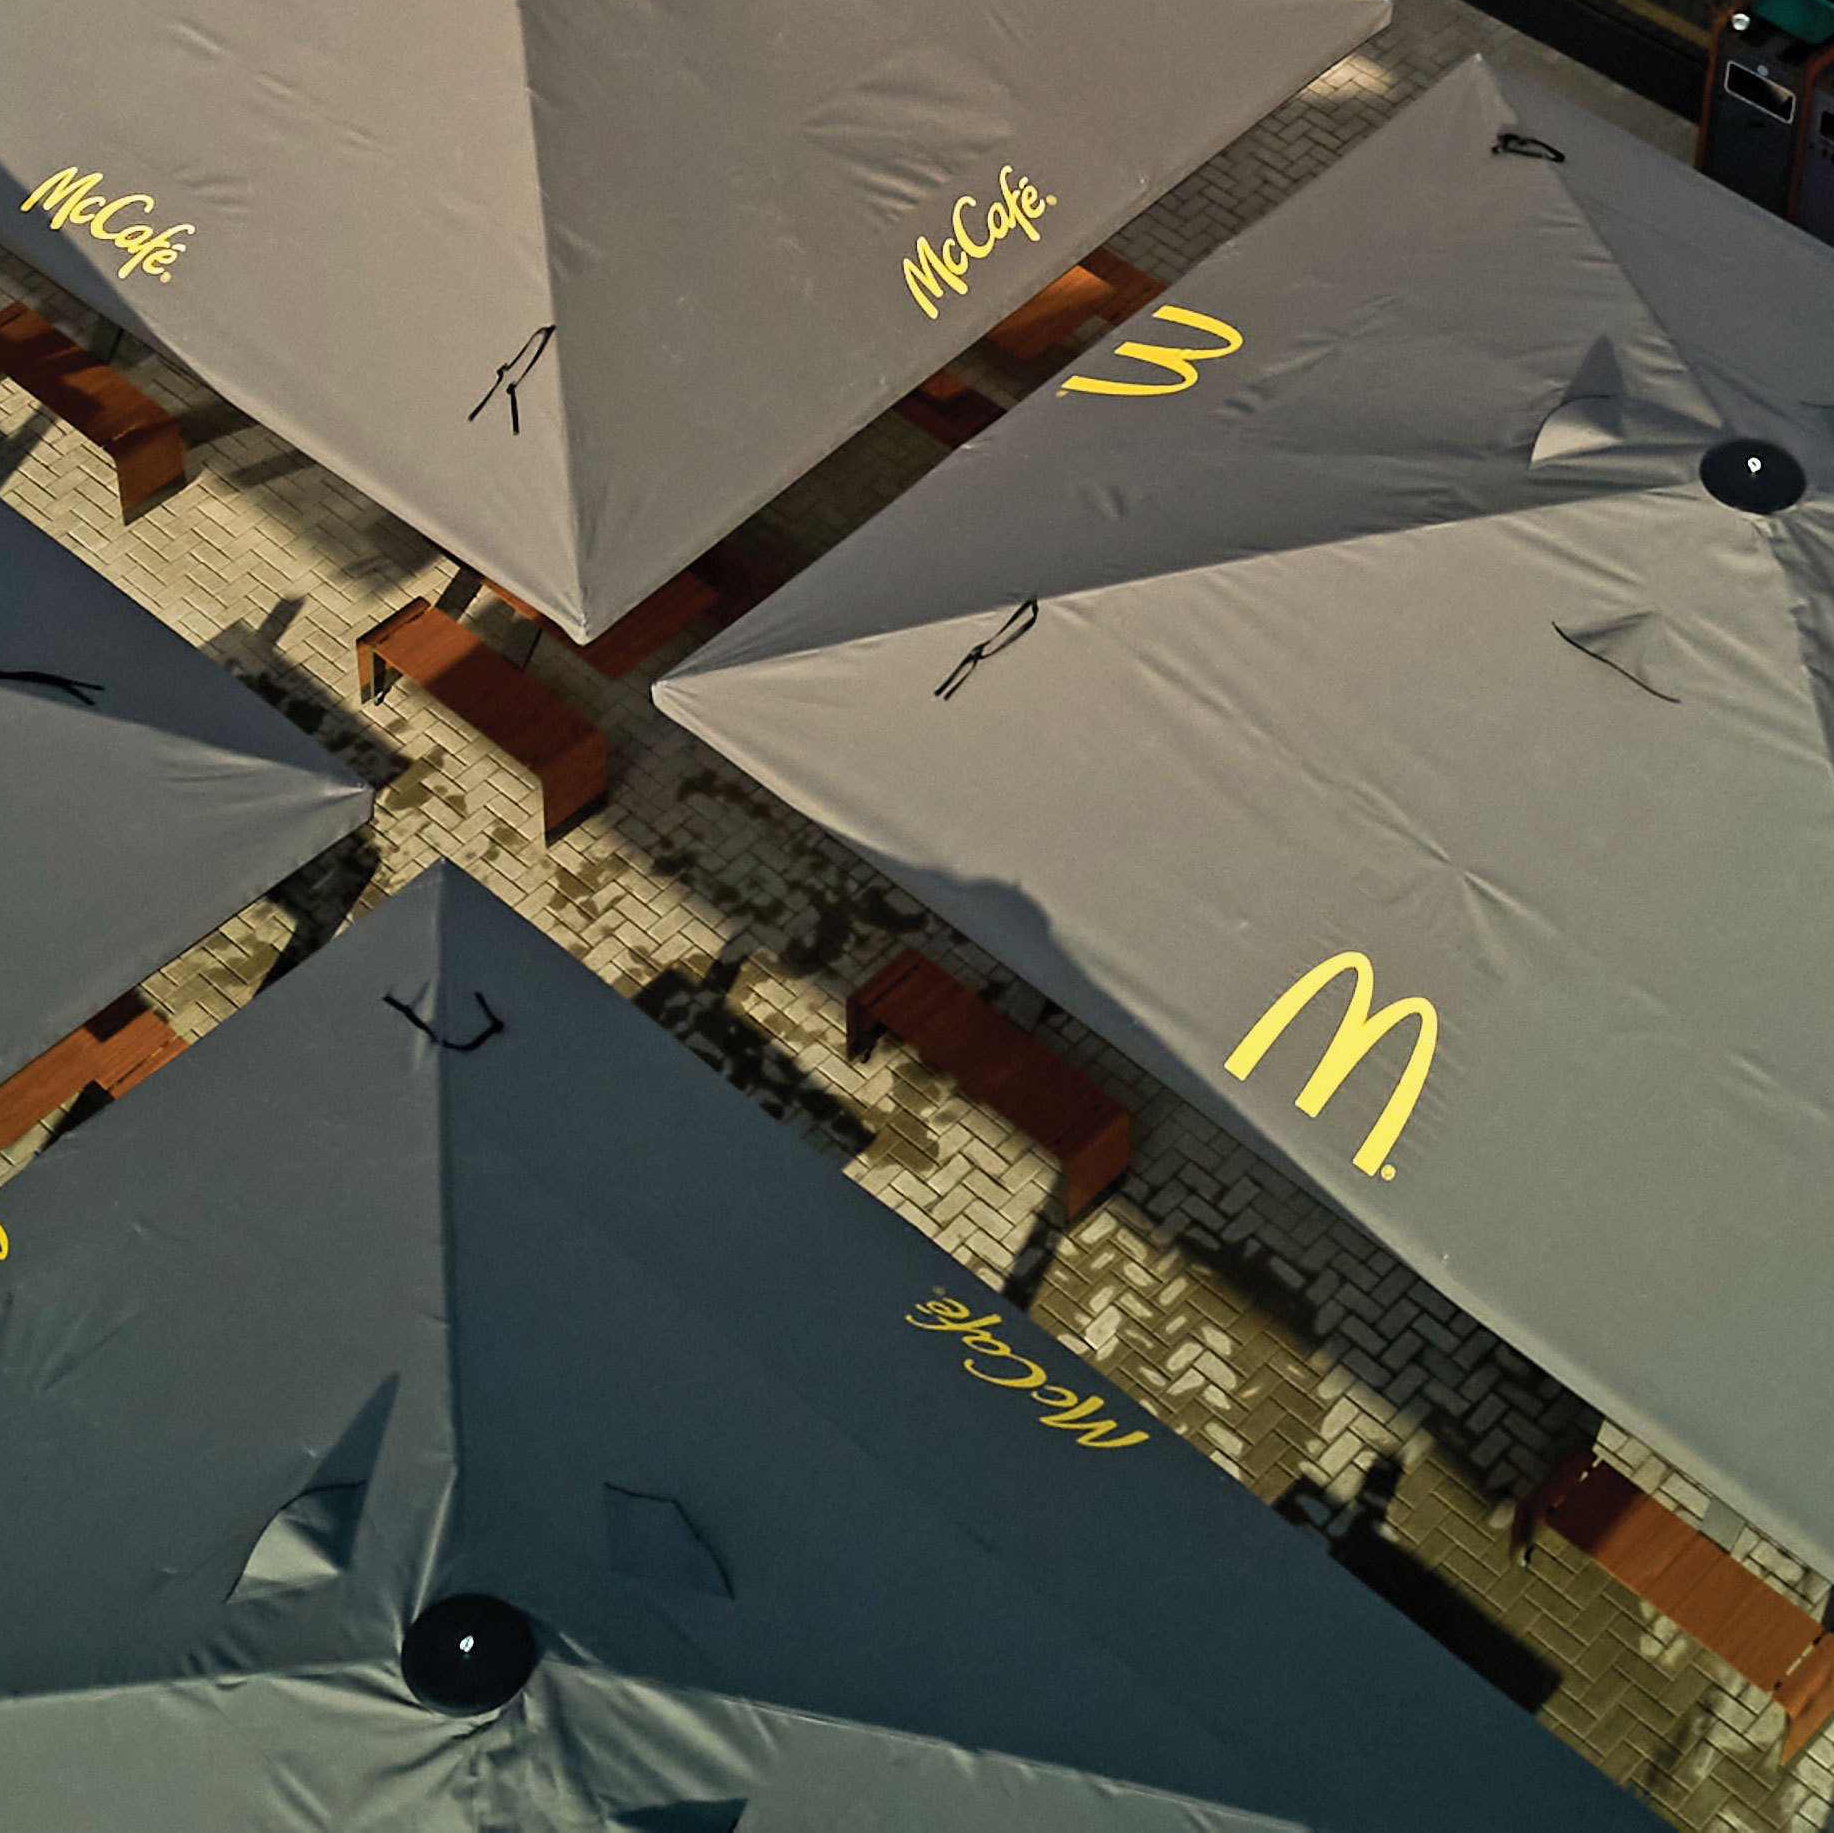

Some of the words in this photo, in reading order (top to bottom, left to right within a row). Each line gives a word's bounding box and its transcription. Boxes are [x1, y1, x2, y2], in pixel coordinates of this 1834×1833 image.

[20, 166, 197, 280] McCafé
[902, 165, 1048, 320] McCafé
[904, 1297, 1150, 1449] McCafé
